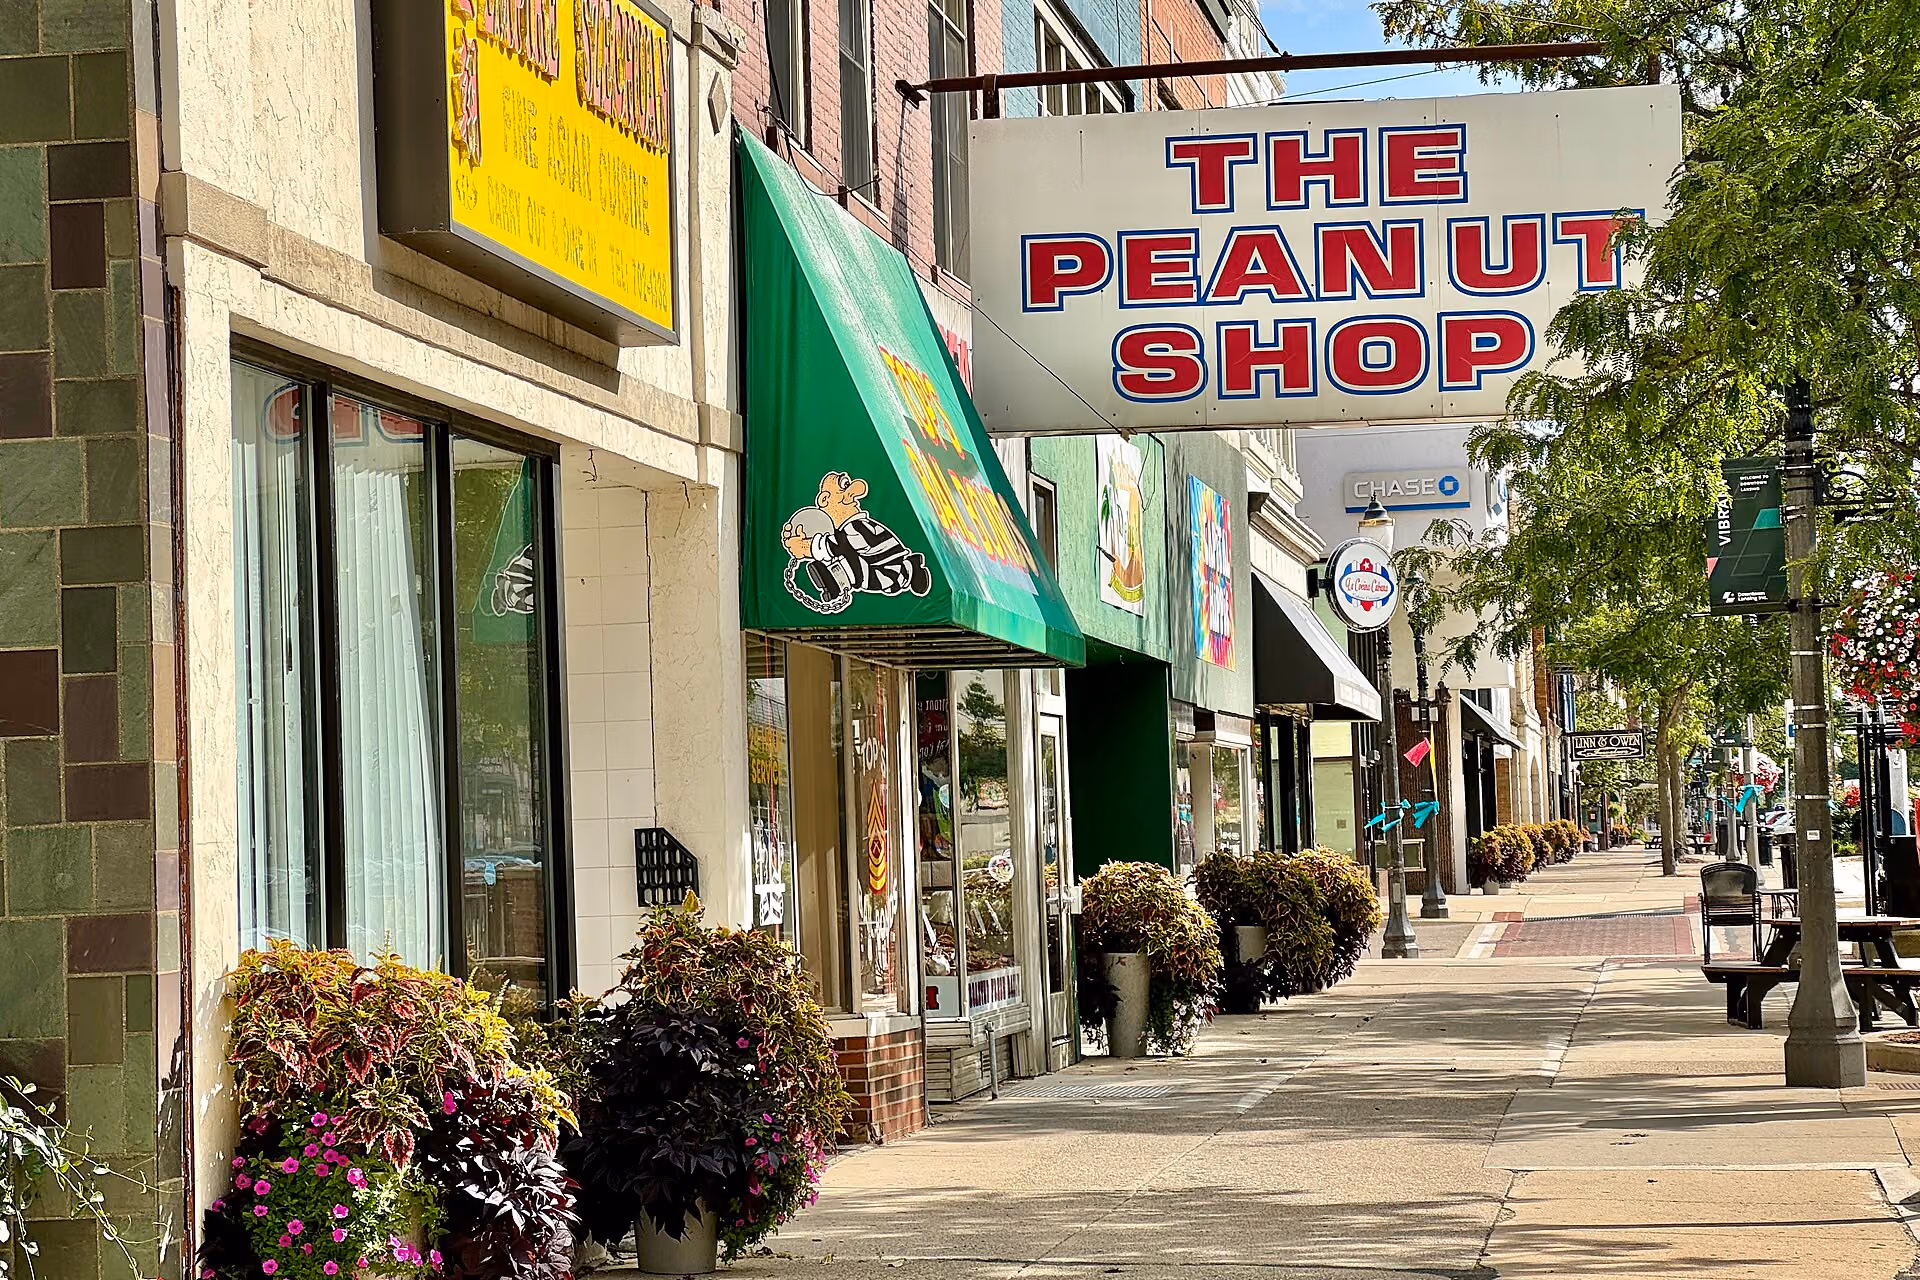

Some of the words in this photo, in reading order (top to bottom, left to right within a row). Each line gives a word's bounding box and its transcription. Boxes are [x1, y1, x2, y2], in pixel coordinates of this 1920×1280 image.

[502, 86, 539, 169] FINE
[547, 113, 592, 201] ASIAN
[599, 148, 650, 237] CUISINE
[1165, 122, 1468, 214] THE
[487, 174, 521, 239] CARRY
[526, 196, 547, 250] OUT
[563, 216, 585, 272] DINE
[588, 231, 598, 277] IN
[1020, 208, 1645, 313] PEANUT
[1111, 309, 1535, 404] SHOP
[901, 438, 982, 552] BAIL
[946, 468, 1039, 578] BONDS
[1353, 478, 1436, 499] CHASE
[1575, 737, 1596, 748] LINN
[1597, 736, 1607, 748] &
[1609, 734, 1641, 747] OWEN
